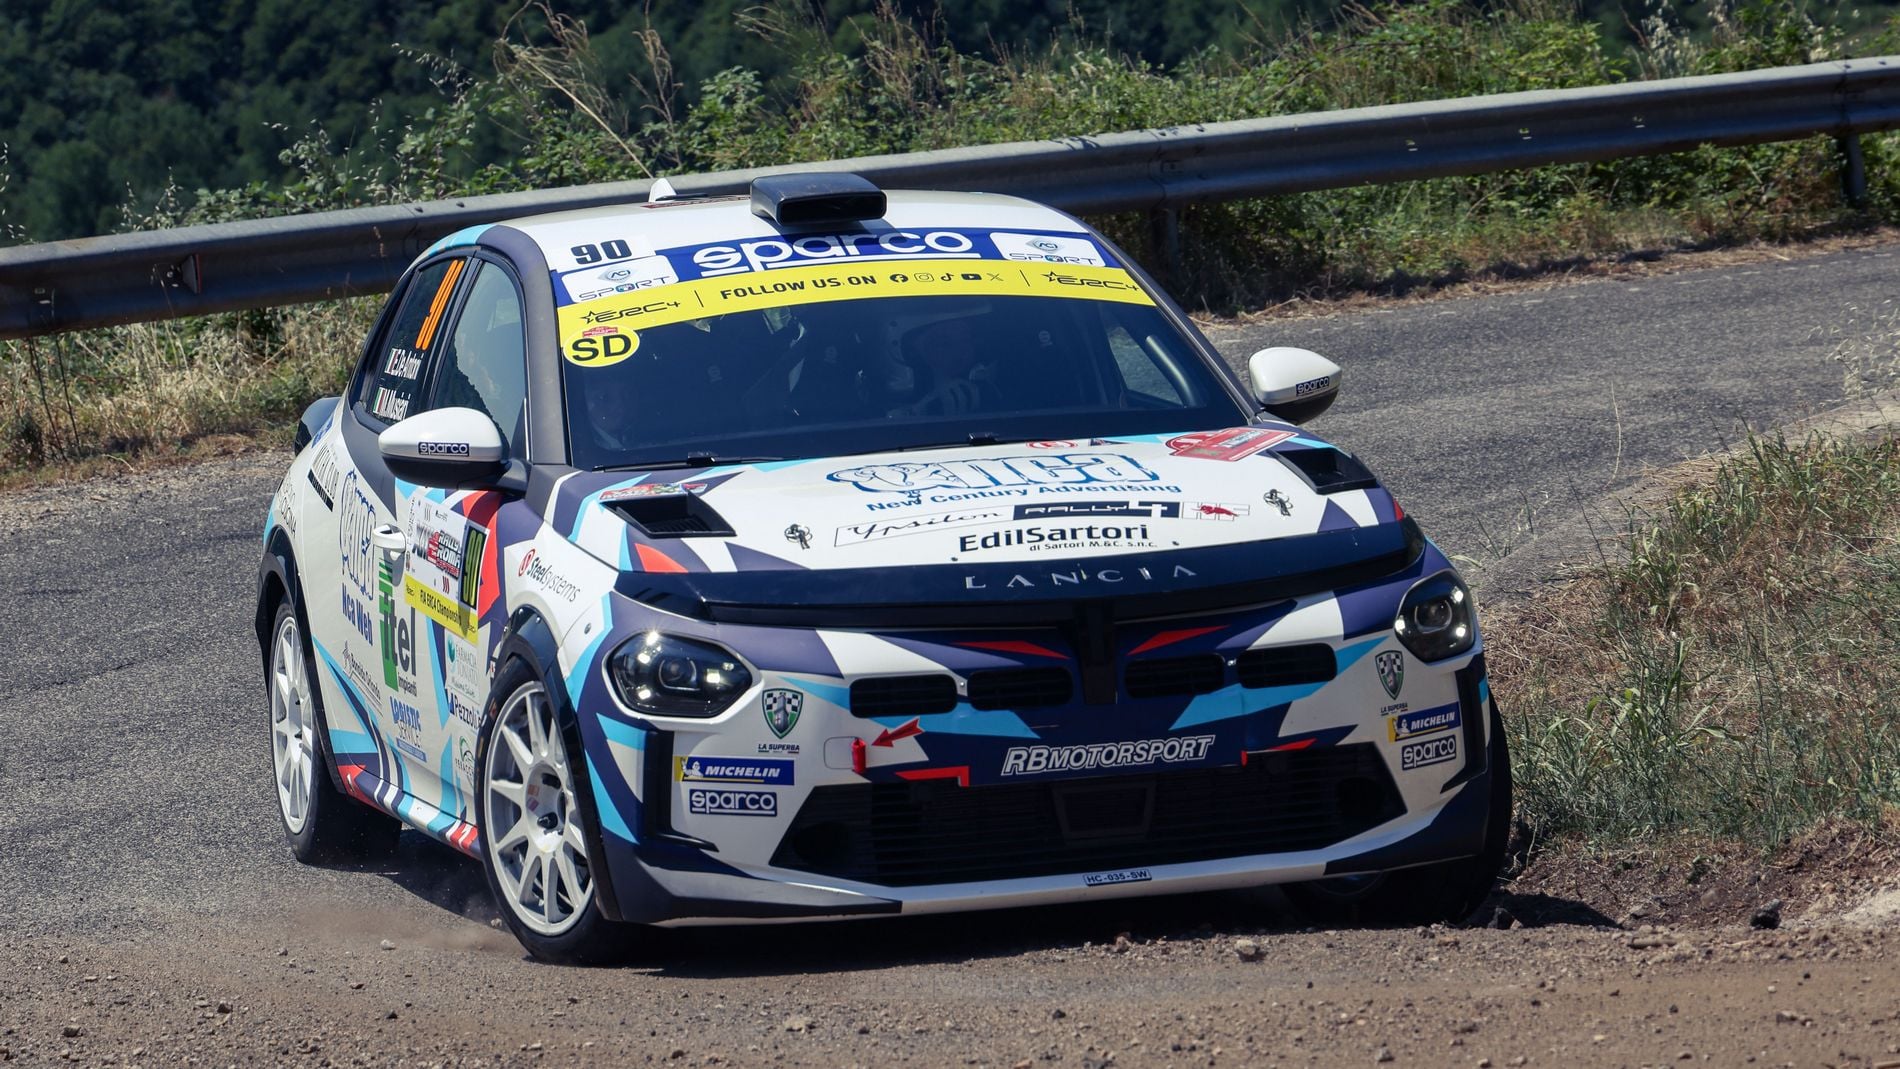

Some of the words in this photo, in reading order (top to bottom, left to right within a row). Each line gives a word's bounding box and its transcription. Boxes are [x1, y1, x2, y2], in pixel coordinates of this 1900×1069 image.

[571, 239, 632, 265] 90
[693, 231, 981, 277] sparco
[1008, 253, 1097, 265] SPORT
[579, 275, 670, 302] SPORT
[720, 280, 805, 301] FOLLOW
[813, 277, 842, 289] US
[847, 275, 877, 286] ON
[571, 334, 632, 362] SD
[1297, 376, 1330, 396] sparco
[419, 442, 468, 457] sparco
[866, 498, 923, 513] New
[930, 486, 1028, 503] Century
[1038, 482, 1182, 495] Advertising
[847, 511, 1005, 540] Ypsilon
[959, 524, 1149, 552] EdilSartori
[1029, 544, 1041, 552] di
[1045, 541, 1085, 550] Sartori
[463, 529, 484, 608] 90
[965, 564, 1198, 590] LANCIA
[1410, 711, 1456, 730] MICHELIN
[758, 743, 768, 751] LA
[768, 743, 801, 752] SUPERBA
[1000, 734, 1216, 777] RBMOTORSPORT
[1403, 737, 1456, 769] sparco
[704, 765, 782, 779] MICHELIN
[691, 791, 776, 814] sparco
